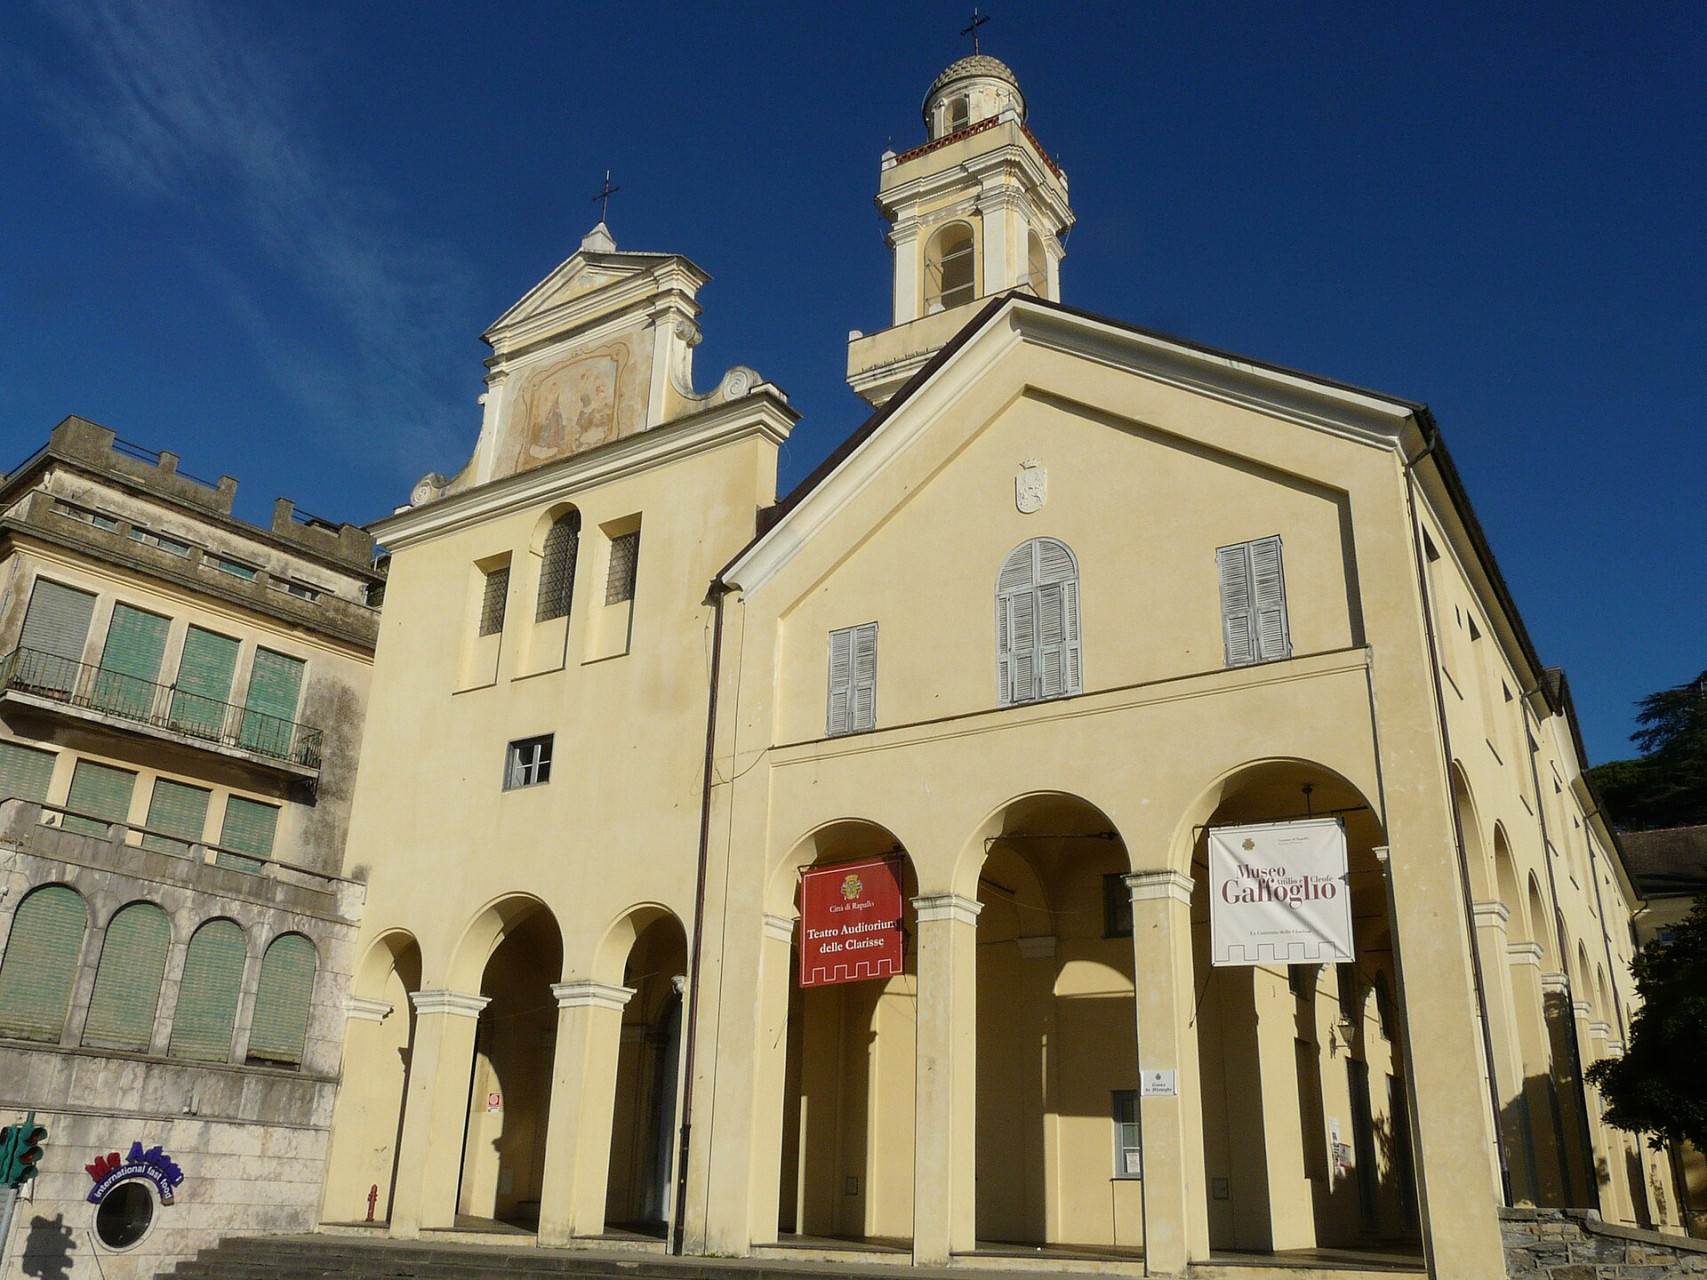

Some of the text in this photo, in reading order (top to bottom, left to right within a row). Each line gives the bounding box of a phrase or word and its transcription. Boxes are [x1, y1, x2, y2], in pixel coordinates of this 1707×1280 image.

[1237, 864, 1286, 879] Museo
[1222, 875, 1337, 910] Gaffoglio
[829, 901, 874, 913] Città di Rapallo
[807, 920, 897, 939] Teatro Auditorium
[820, 938, 884, 954] delle Clarisse
[147, 1167, 161, 1181] fast
[161, 1179, 172, 1199] food
